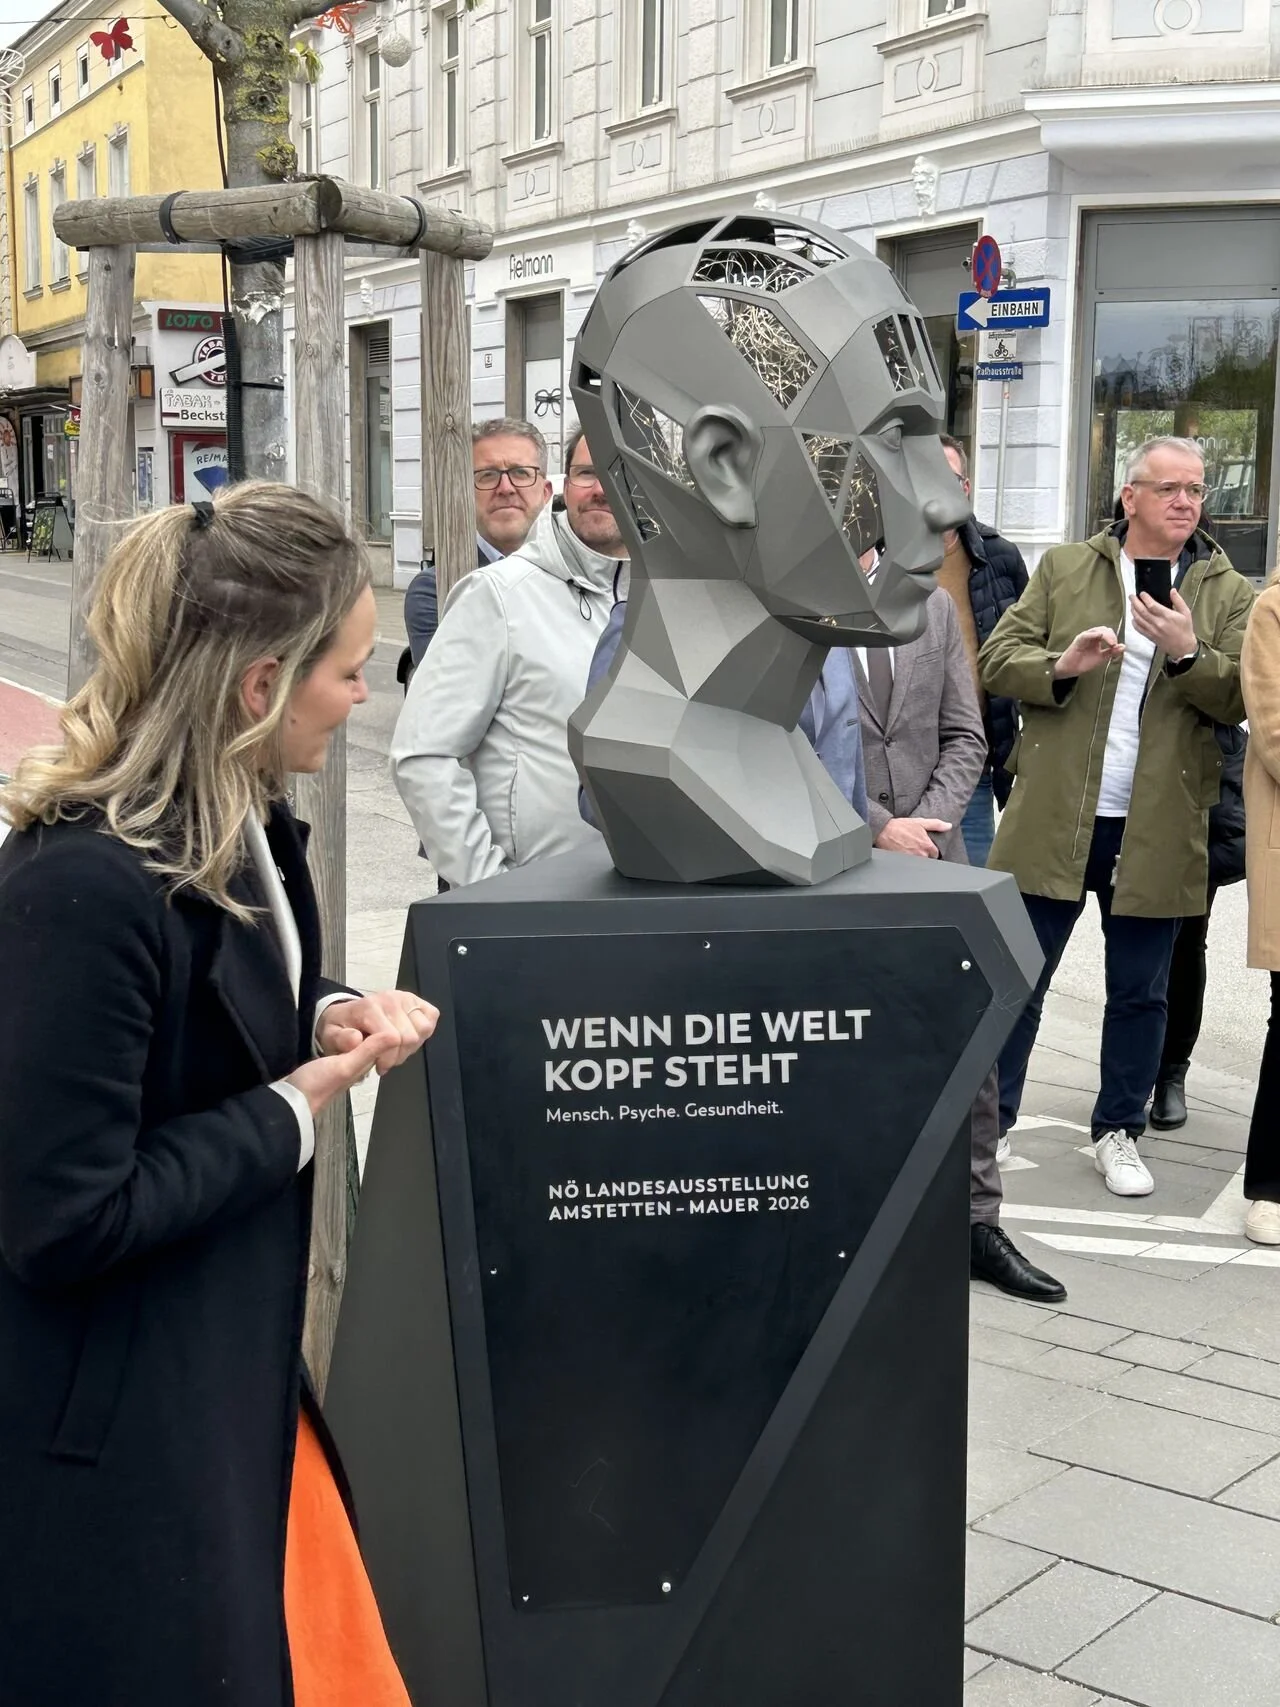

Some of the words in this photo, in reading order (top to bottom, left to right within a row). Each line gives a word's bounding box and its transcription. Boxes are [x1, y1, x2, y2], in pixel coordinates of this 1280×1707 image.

[991, 302, 1039, 316] EINBAHN
[165, 313, 214, 329] LOTTO
[199, 340, 224, 358] TABA
[164, 393, 212, 409] TABAK
[180, 409, 226, 421] Beckst
[196, 453, 229, 465] RE/MA
[541, 1014, 672, 1050] WENN
[684, 1012, 752, 1046] DIE
[760, 1008, 872, 1043] WELT
[544, 1057, 655, 1092] KOPF
[664, 1052, 799, 1088] STEHT
[546, 1105, 615, 1123] Mensch.
[618, 1104, 681, 1124] Psyche.
[684, 1100, 784, 1118] Gesundheit.
[548, 1179, 580, 1200] NÖ
[585, 1174, 810, 1198] LANDESAUSSTELLUNG
[548, 1201, 671, 1221] AMSTETTEN
[689, 1198, 760, 1216] MAUER
[767, 1195, 810, 1211] 2026
